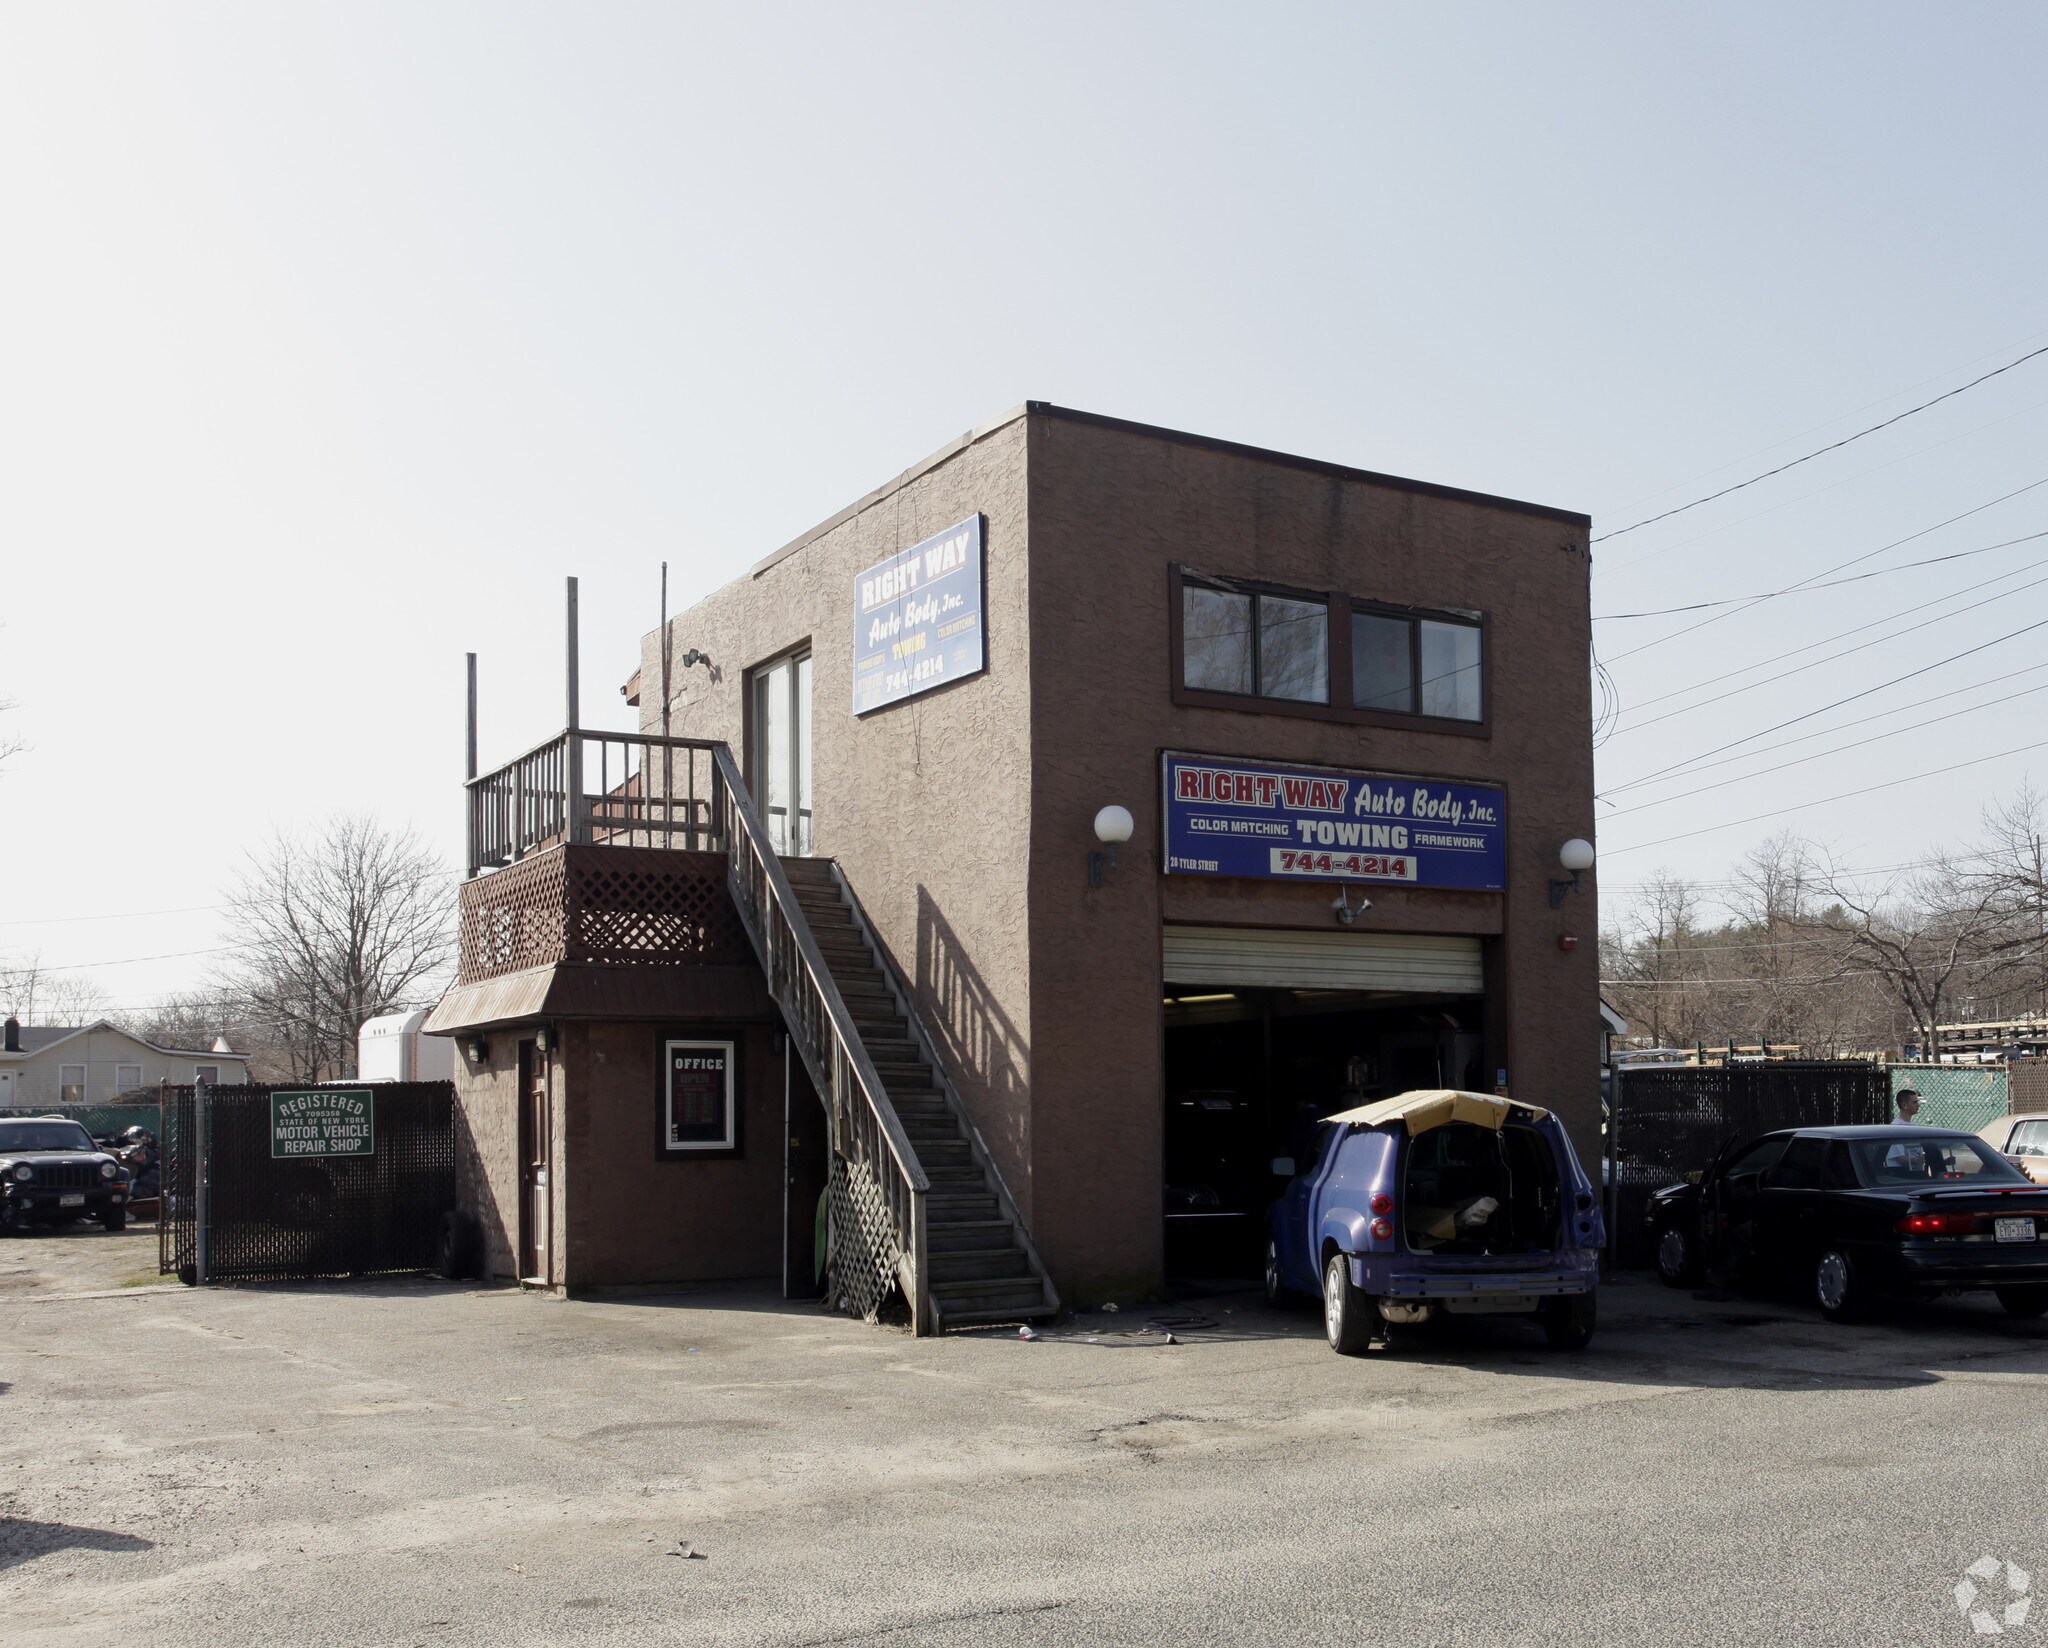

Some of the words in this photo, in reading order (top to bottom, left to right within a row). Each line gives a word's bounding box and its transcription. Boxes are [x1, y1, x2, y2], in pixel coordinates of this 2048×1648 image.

[862, 557, 921, 610] RIGHT
[925, 532, 969, 579] WAY
[869, 613, 900, 648] Auto
[892, 632, 927, 661] TOWING
[886, 653, 944, 693] 744-4214
[1176, 767, 1277, 807] RIGHT
[1283, 778, 1347, 812] WAY
[1354, 784, 1405, 817] Auto
[1190, 818, 1228, 833] COLOR
[1231, 821, 1289, 836] MATCHING
[1297, 819, 1408, 850] TOWING
[1414, 833, 1485, 849] FRAMEWORK
[1170, 856, 1178, 867] 28
[1179, 858, 1197, 870] TYLER
[1198, 860, 1219, 872] STREET
[1280, 852, 1407, 877] 744-4214
[675, 1058, 723, 1070] OFFICE
[680, 1073, 709, 1084] OPEN
[279, 1094, 364, 1117] REGISTERED
[276, 1126, 318, 1140] MOTOR
[323, 1124, 369, 1138] VEHICLE
[279, 1118, 304, 1126] STATE
[322, 1117, 340, 1125] NEW
[284, 1139, 326, 1154] REPAIR
[330, 1139, 362, 1152] SHOP
